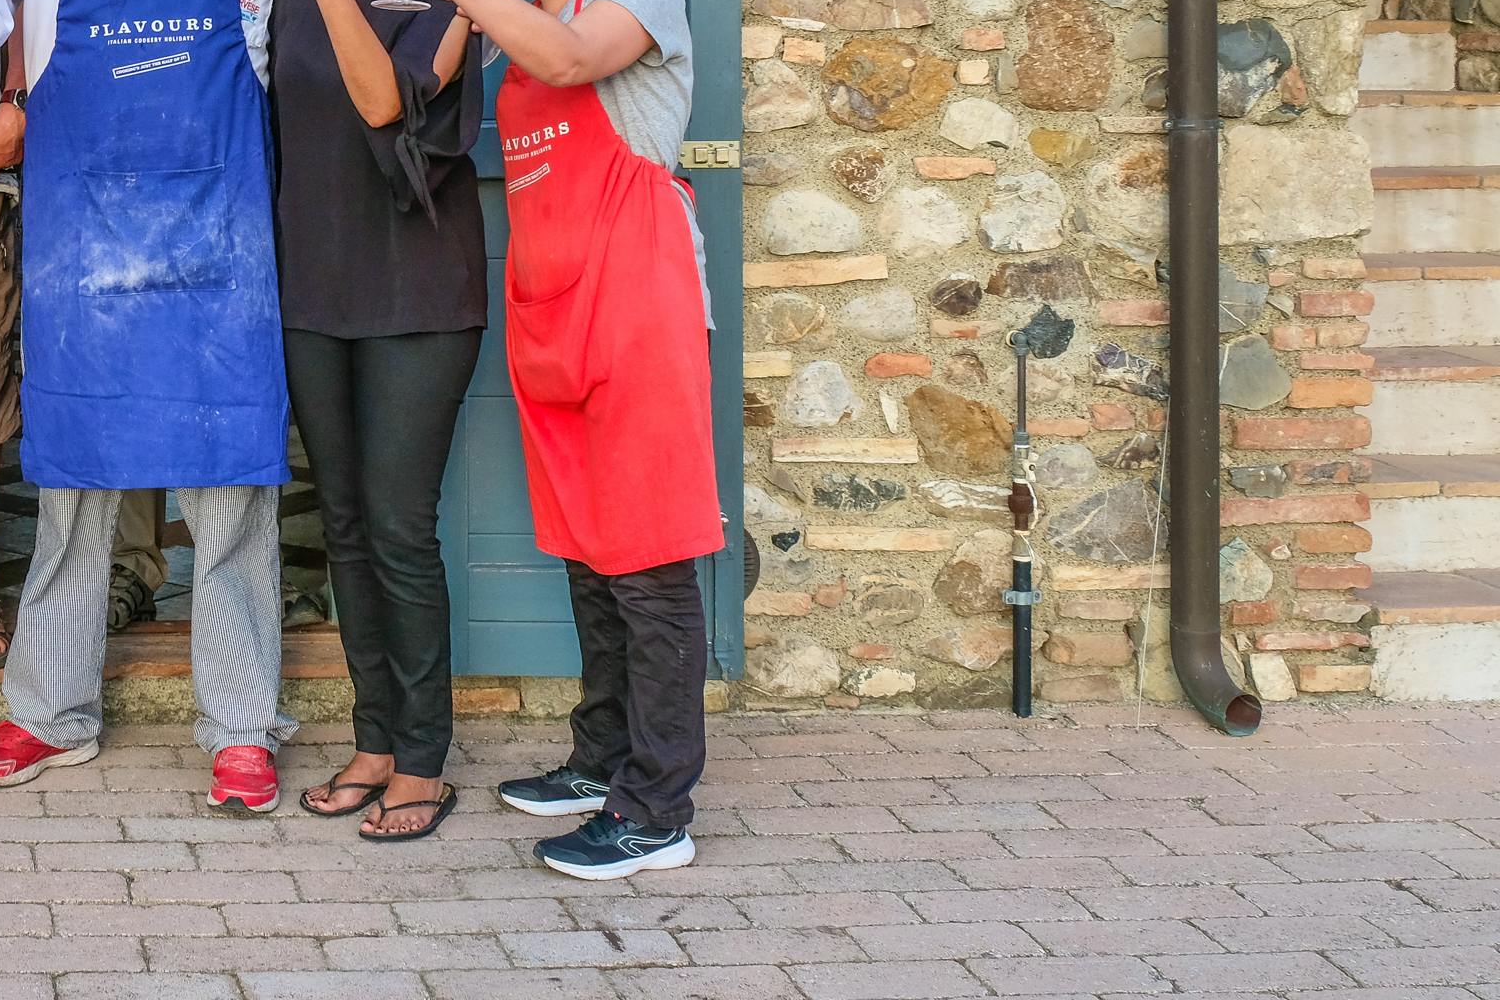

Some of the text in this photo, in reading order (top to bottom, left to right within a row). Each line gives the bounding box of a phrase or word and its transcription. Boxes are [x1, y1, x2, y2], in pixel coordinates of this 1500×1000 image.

[89, 18, 213, 38] FLAVOURS
[107, 38, 132, 46] ITALIAN
[164, 35, 194, 43] HOLIDAYS
[502, 121, 570, 151] AVOURS
